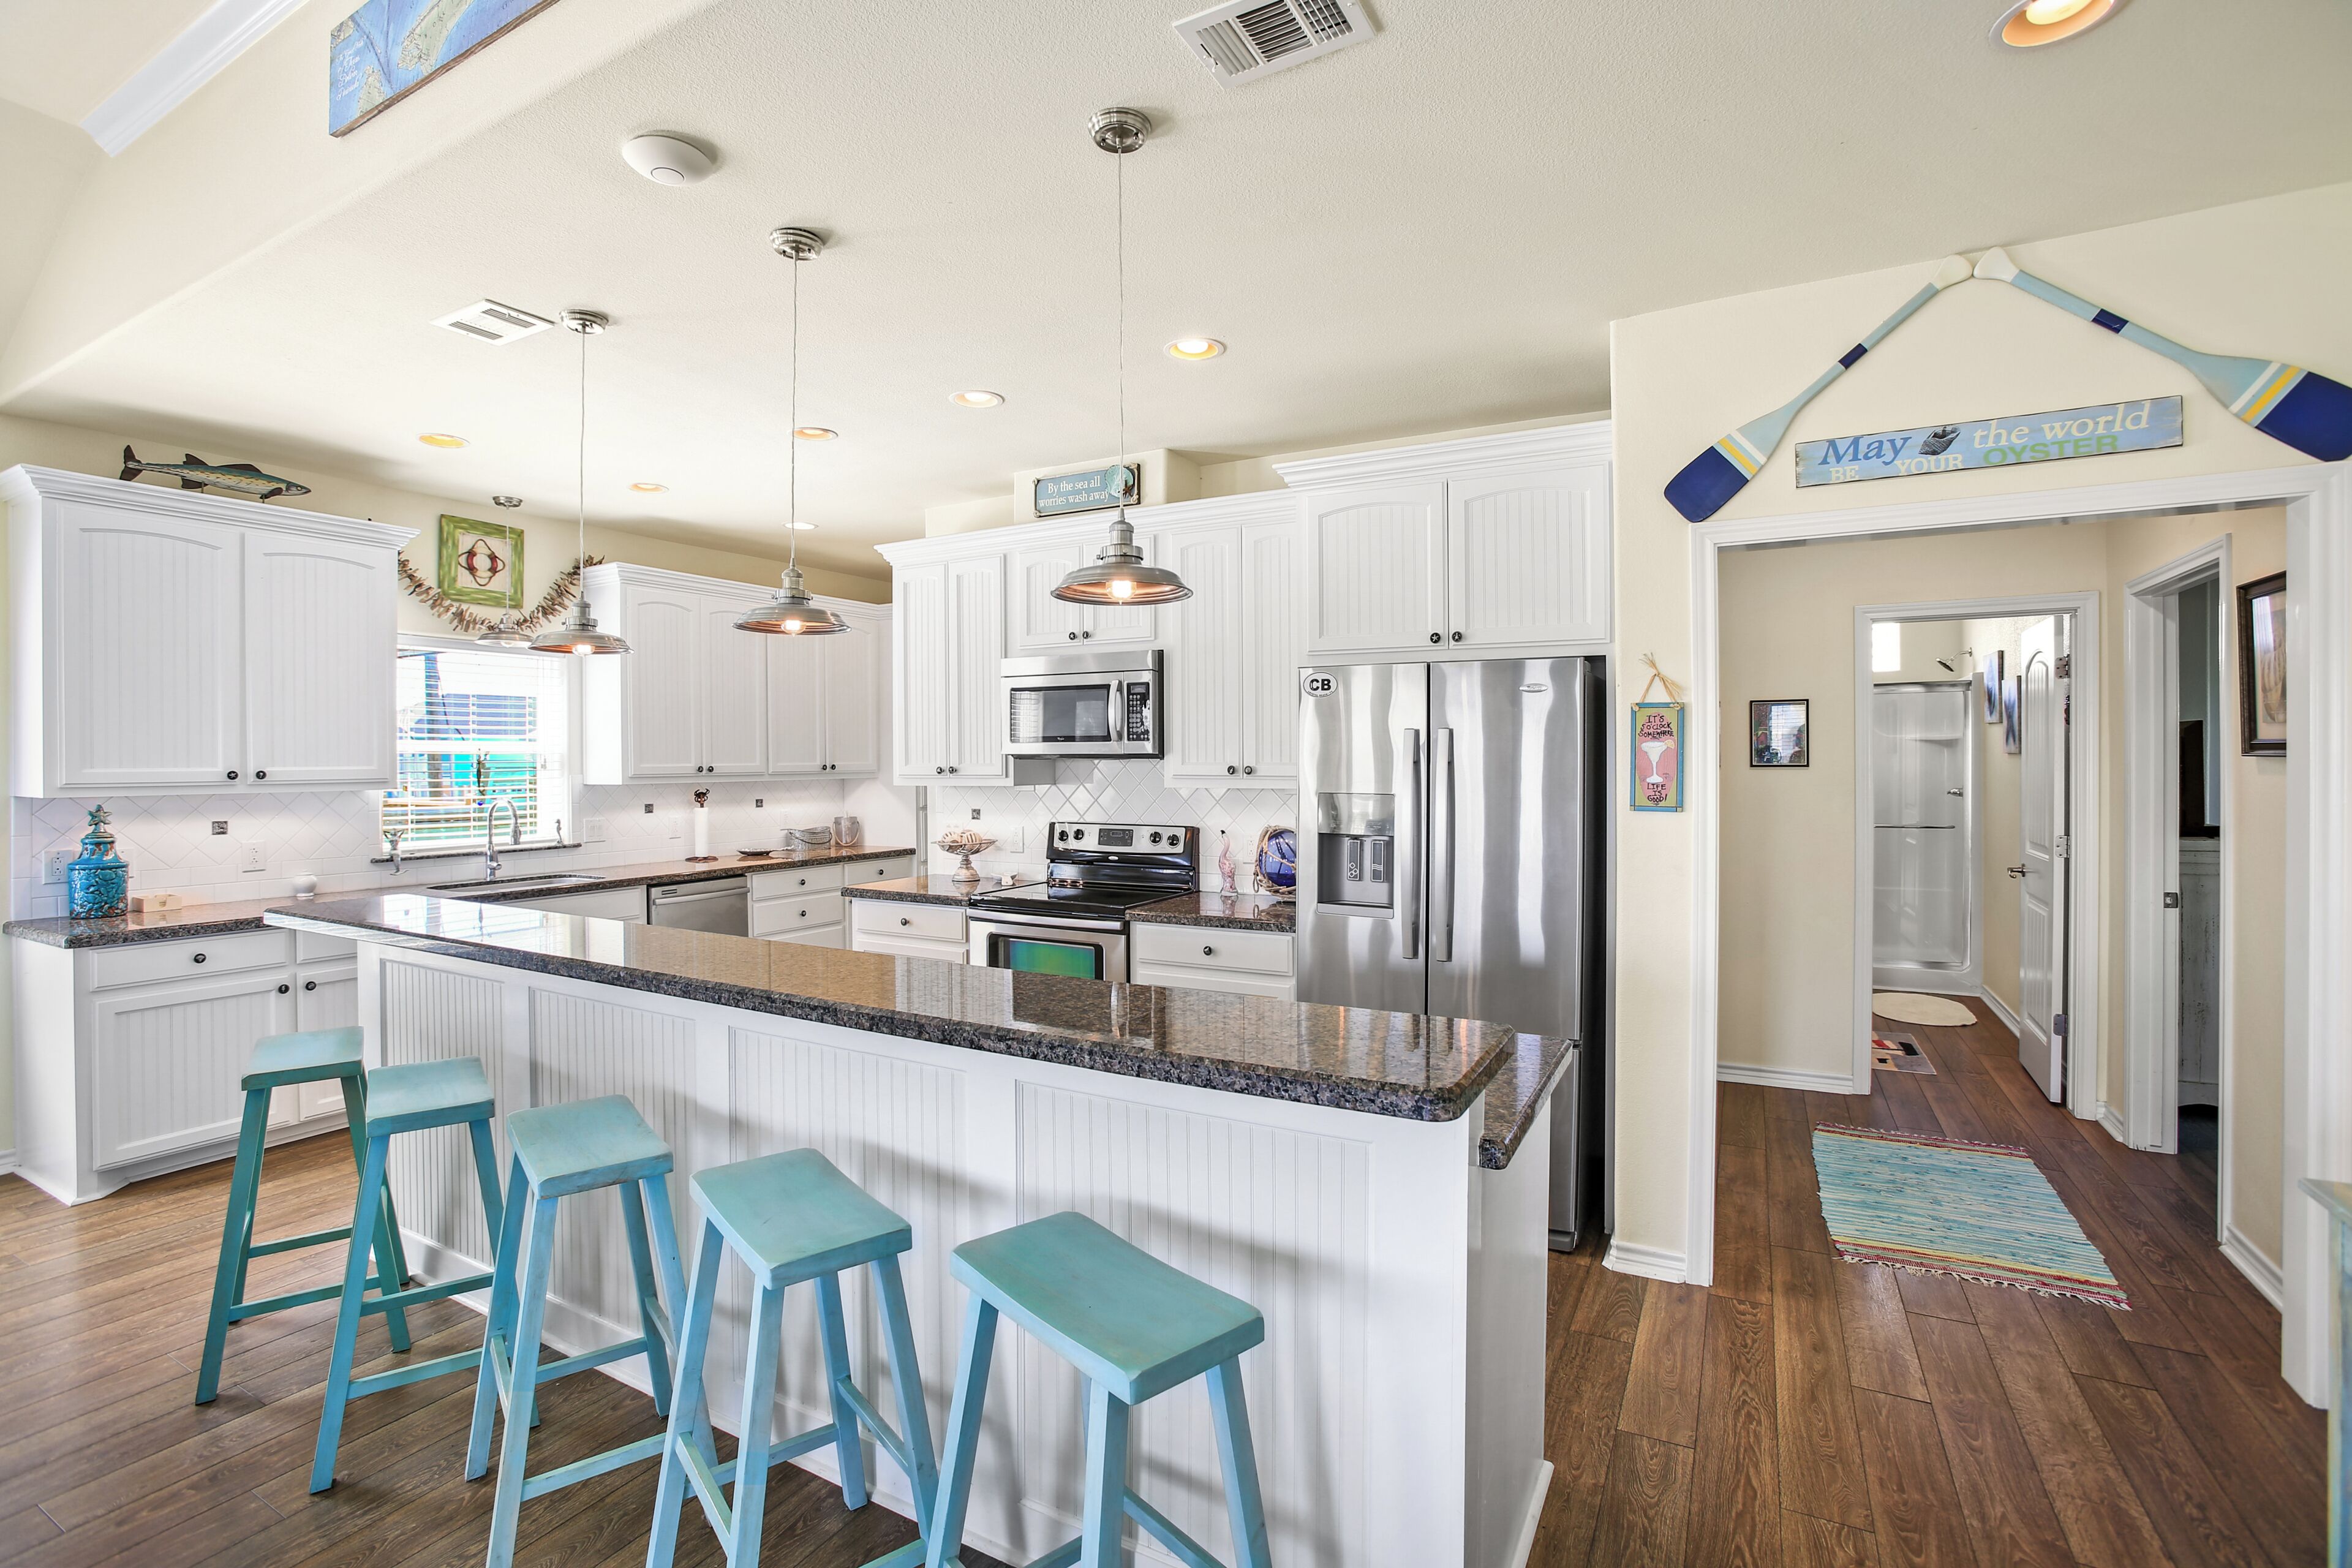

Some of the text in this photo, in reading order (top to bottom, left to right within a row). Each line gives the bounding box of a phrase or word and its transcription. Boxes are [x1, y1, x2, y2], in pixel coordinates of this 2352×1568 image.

[1818, 400, 2151, 466] May the world
[1830, 435, 2118, 482] BE YOUR OYSTER
[1048, 476, 1101, 496] By the sea all
[1039, 490, 1109, 507] worries wash away
[1310, 678, 1331, 691] CB
[1646, 714, 1664, 723] IT'S
[1646, 722, 1672, 730] O'CLOCK
[1638, 729, 1675, 738] SOMEWHERE
[1647, 794, 1667, 803] GOOD!
